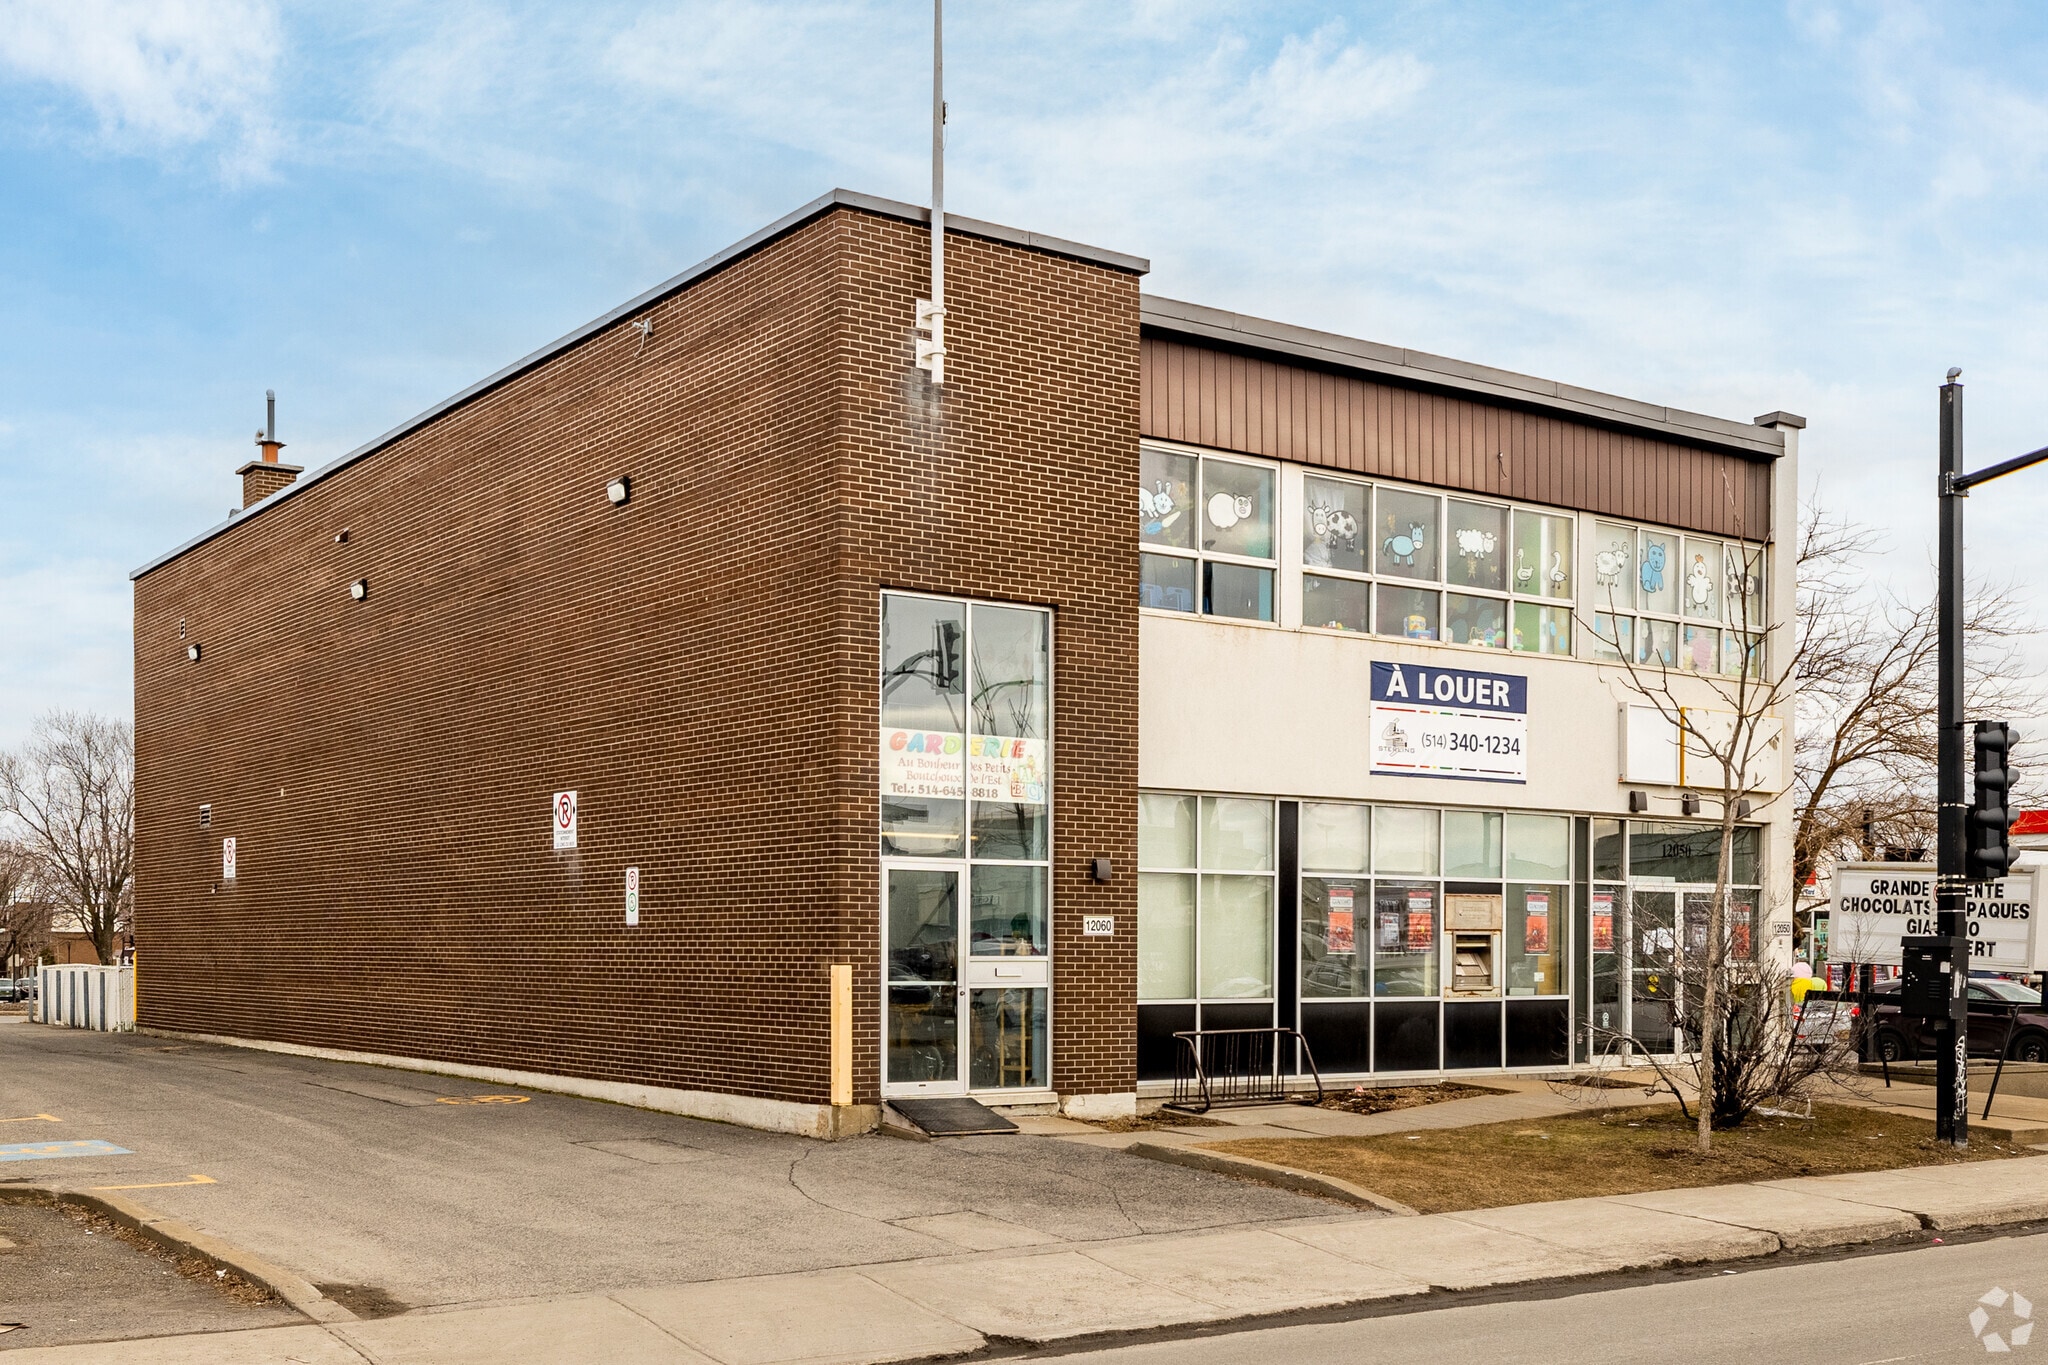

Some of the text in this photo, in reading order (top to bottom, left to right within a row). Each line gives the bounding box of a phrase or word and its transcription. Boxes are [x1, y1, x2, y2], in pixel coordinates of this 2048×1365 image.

[1386, 664, 1510, 707] À LOUER
[889, 731, 1026, 759] GARDERIE
[1421, 732, 1520, 755] (514) 340-1234
[897, 757, 914, 767] Au
[917, 758, 960, 770] Bonheur
[985, 762, 1011, 774] Petits
[891, 782, 998, 799] Tel.: 514-6458818
[1662, 843, 1691, 858] 12050
[1870, 879, 2005, 899] GRANDE ENTE
[1840, 896, 1930, 916] CHOCOLATS
[1966, 901, 2031, 919] PAQUES
[1086, 920, 1112, 931] 12060
[1774, 924, 1790, 933] 12050
